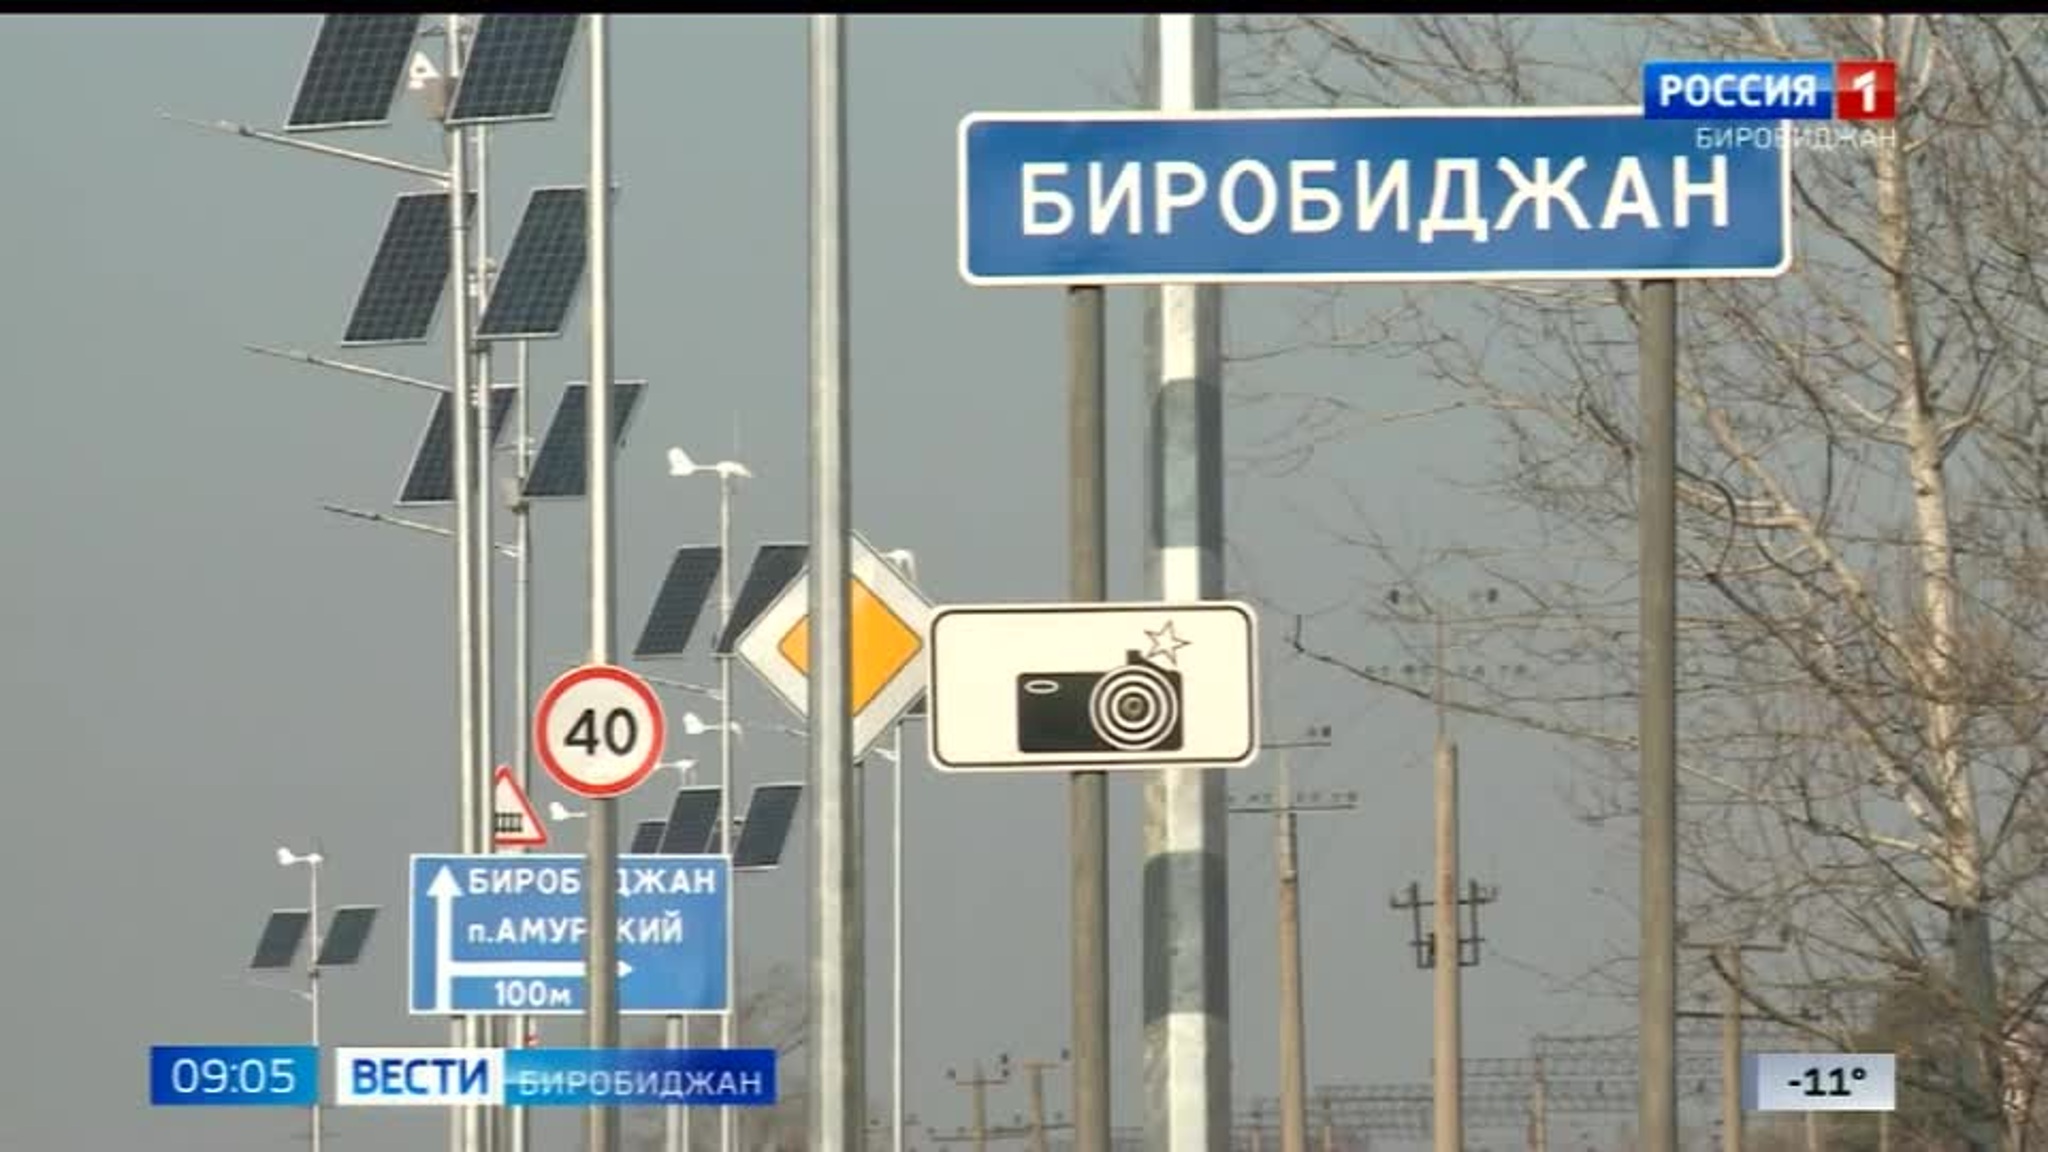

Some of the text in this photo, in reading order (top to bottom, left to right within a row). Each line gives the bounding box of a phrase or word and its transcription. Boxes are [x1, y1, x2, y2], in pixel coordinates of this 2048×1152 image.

[1020, 155, 1730, 244] БИРОБИДЖАН
[564, 707, 638, 756] 40
[468, 867, 716, 897] БИРОБДЖАН
[468, 910, 683, 944] п.АМУРКИЙ
[495, 980, 572, 1007] 100м
